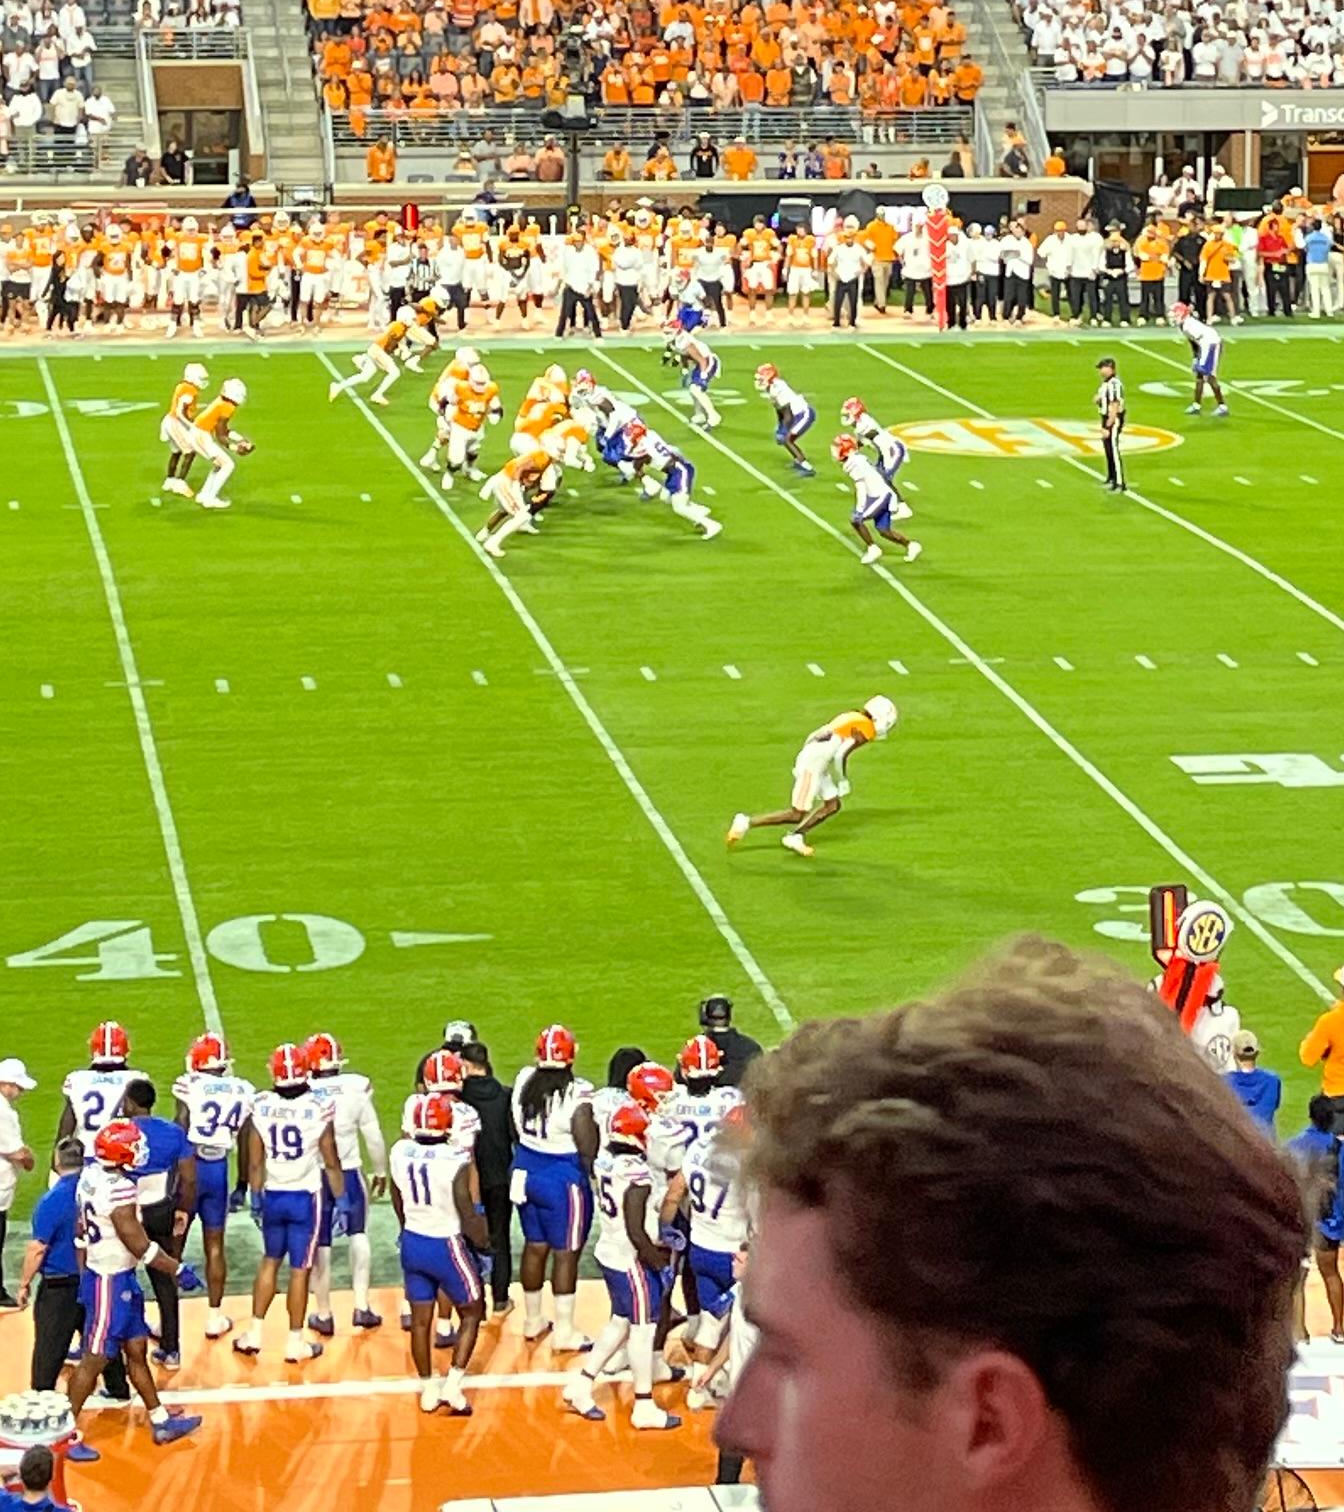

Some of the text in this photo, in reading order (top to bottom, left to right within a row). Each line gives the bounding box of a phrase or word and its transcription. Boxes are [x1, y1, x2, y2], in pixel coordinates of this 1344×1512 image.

[5, 913, 366, 982] 40
[1187, 912, 1226, 956] SEC
[196, 1100, 243, 1138] 34
[268, 1122, 304, 1161] 19
[407, 1162, 432, 1206] 11
